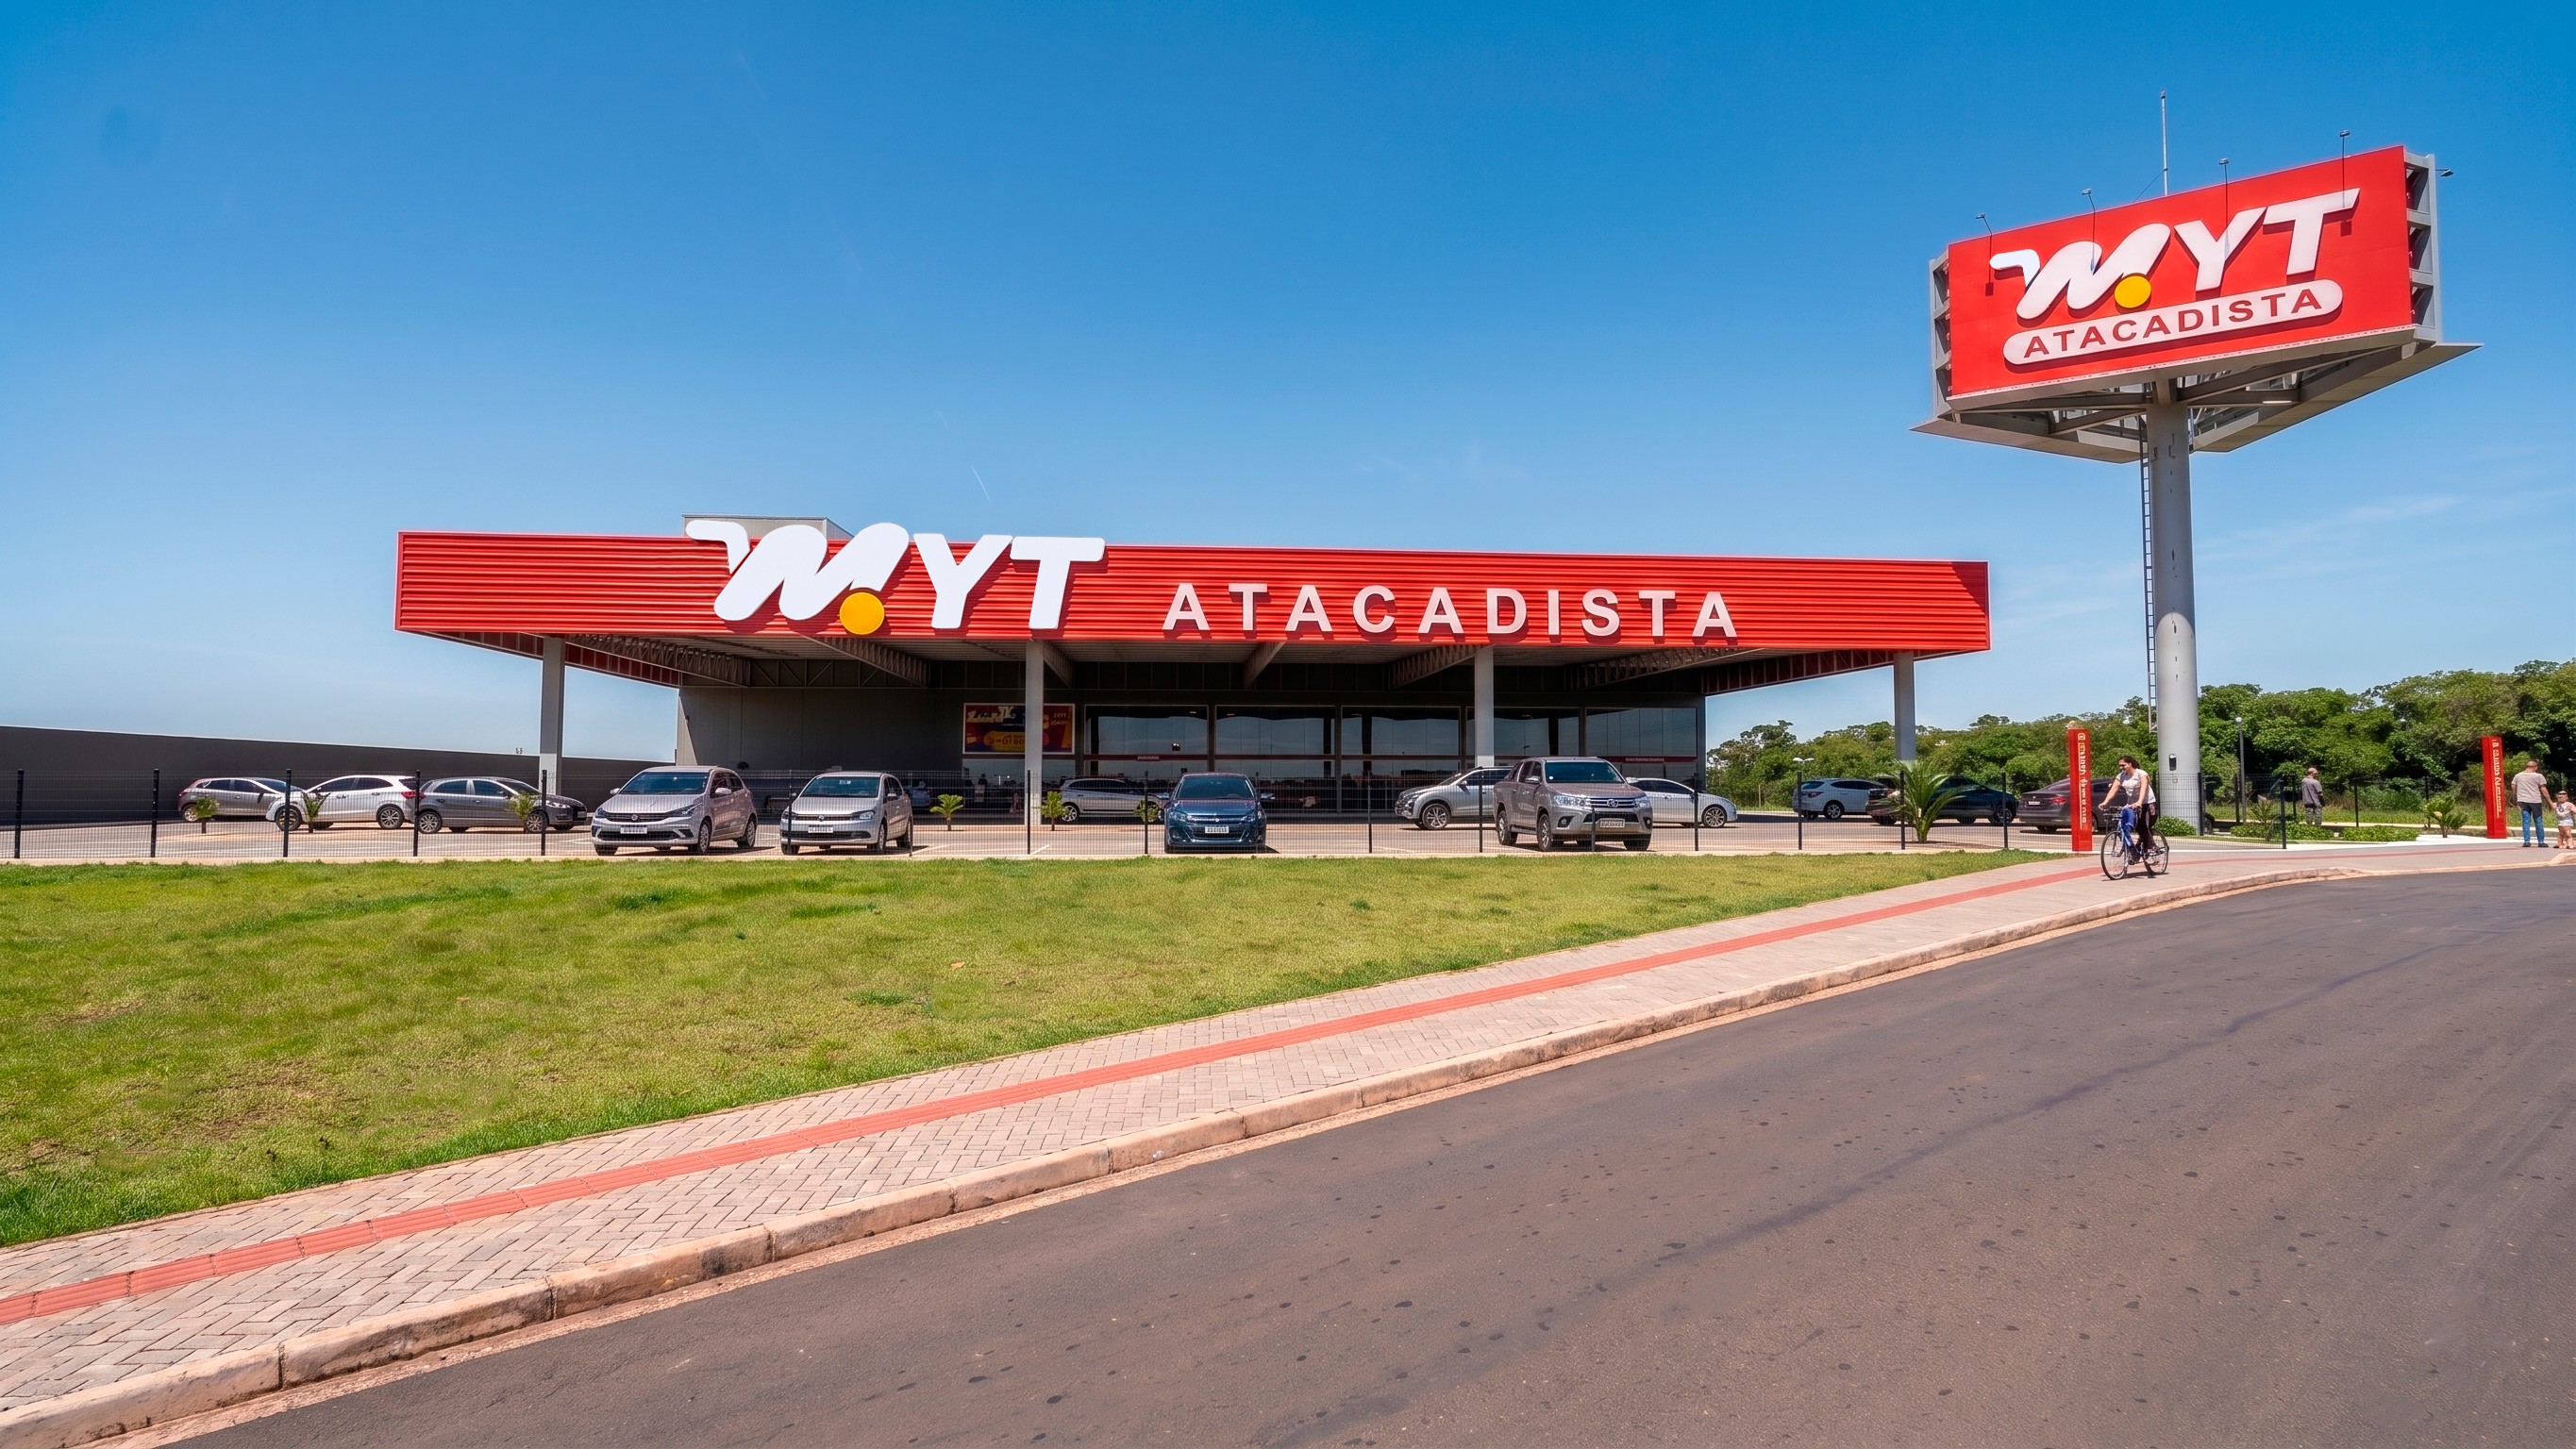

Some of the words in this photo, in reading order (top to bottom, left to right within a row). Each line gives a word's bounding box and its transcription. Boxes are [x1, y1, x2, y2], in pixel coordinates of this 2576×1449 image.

[1990, 188, 2360, 320] MYT
[2023, 289, 2322, 358] ATACADISTA
[685, 520, 1106, 629] MYT
[1162, 583, 1737, 638] ATACADISTA
